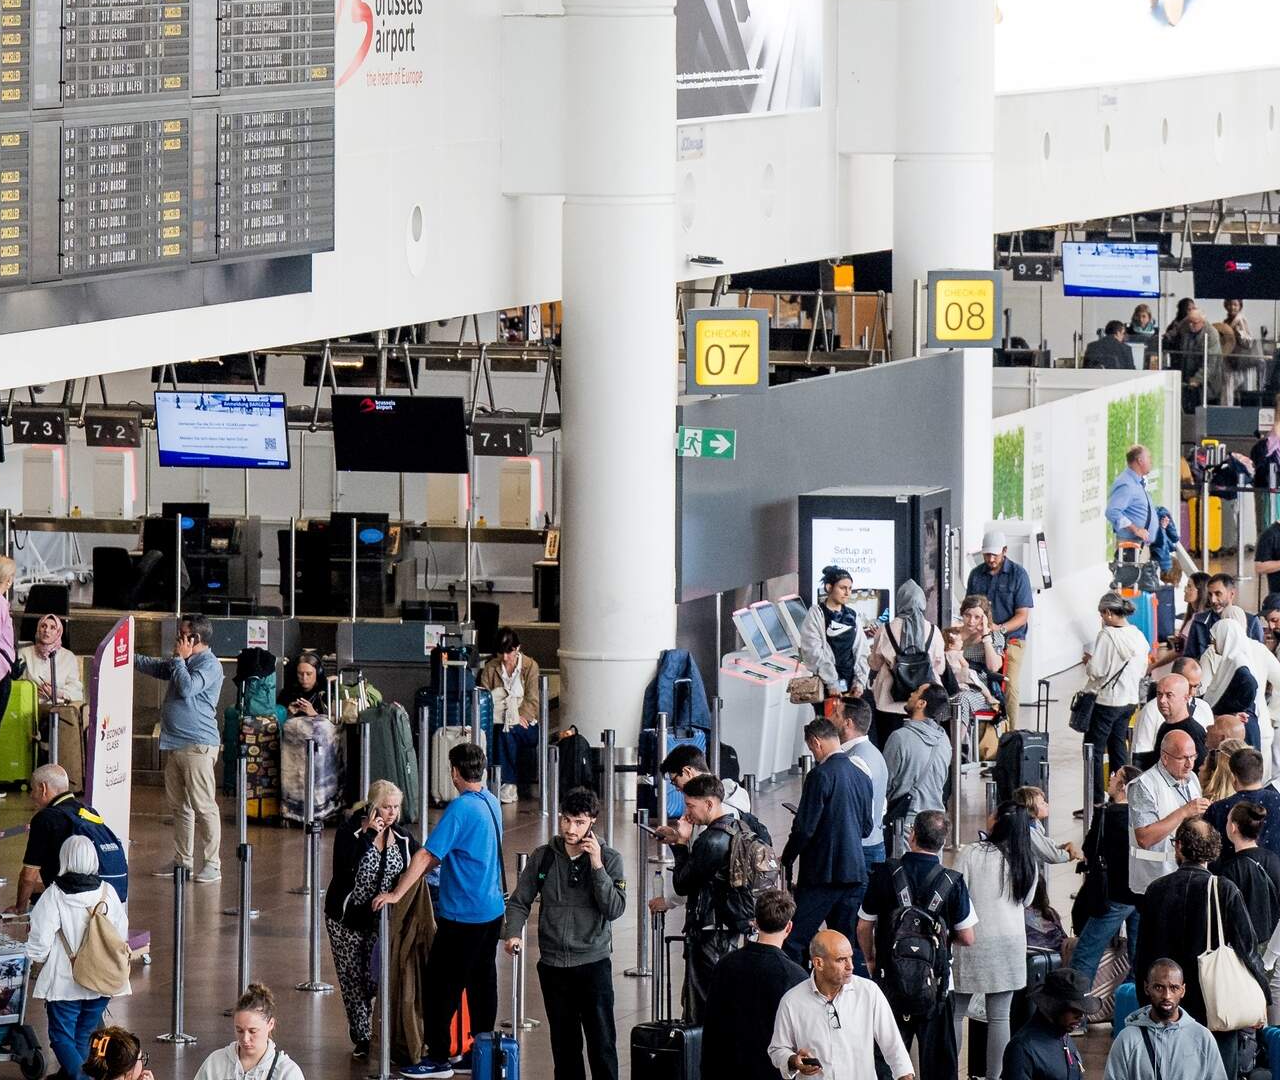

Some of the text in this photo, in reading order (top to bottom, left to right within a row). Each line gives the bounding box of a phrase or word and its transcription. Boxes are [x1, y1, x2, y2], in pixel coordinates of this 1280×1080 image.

[375, 20, 415, 61] airport
[366, 72, 377, 86] the
[378, 70, 394, 86] heart
[401, 67, 423, 88] Europe
[943, 288, 986, 298] CHECK-IN
[945, 302, 985, 331] 08
[704, 329, 751, 338] CHECK-IN
[704, 344, 750, 376] 07
[20, 421, 53, 436] 7.3
[93, 425, 127, 439] 7.2
[480, 433, 512, 448] 7.1
[834, 545, 859, 555] Setup
